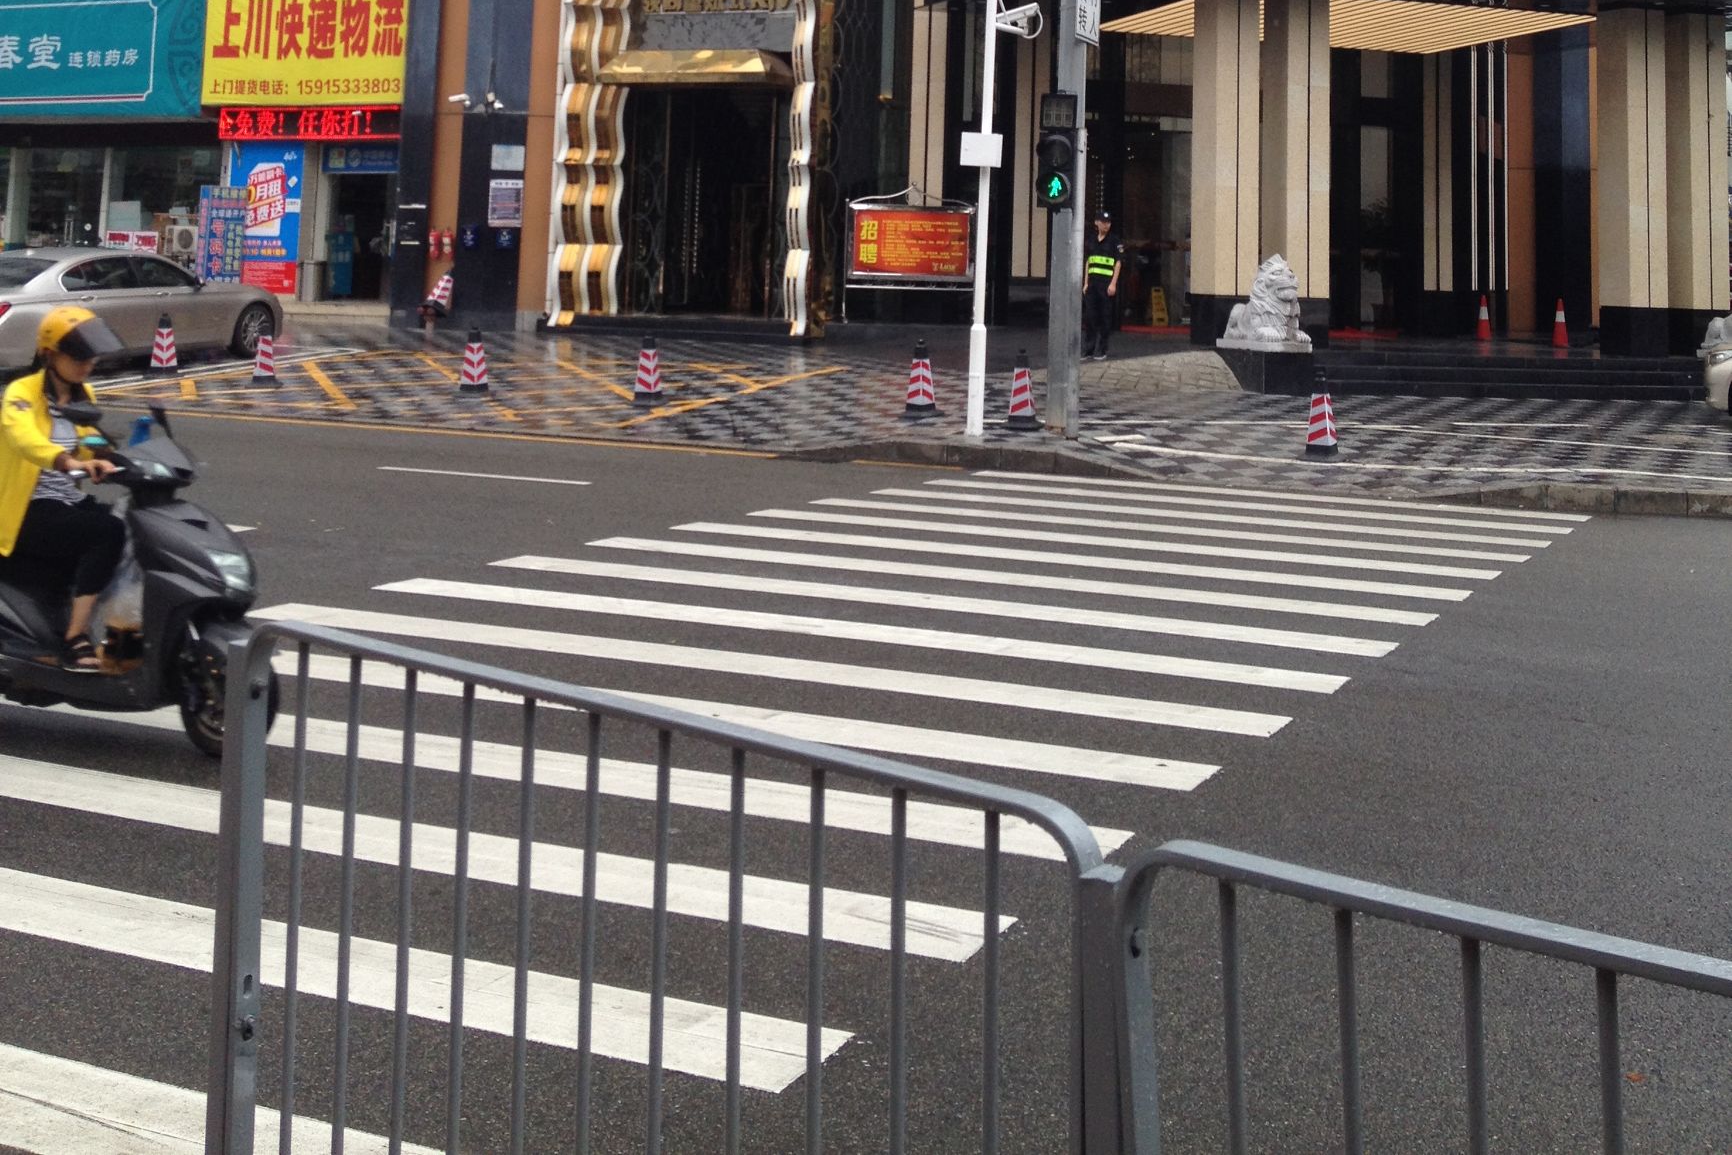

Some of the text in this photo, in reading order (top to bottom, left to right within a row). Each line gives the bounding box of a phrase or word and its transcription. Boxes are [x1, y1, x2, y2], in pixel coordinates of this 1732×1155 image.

[67, 48, 139, 68] 连锁药房
[297, 77, 401, 95] 15915333803
[859, 220, 878, 264] 招聘
